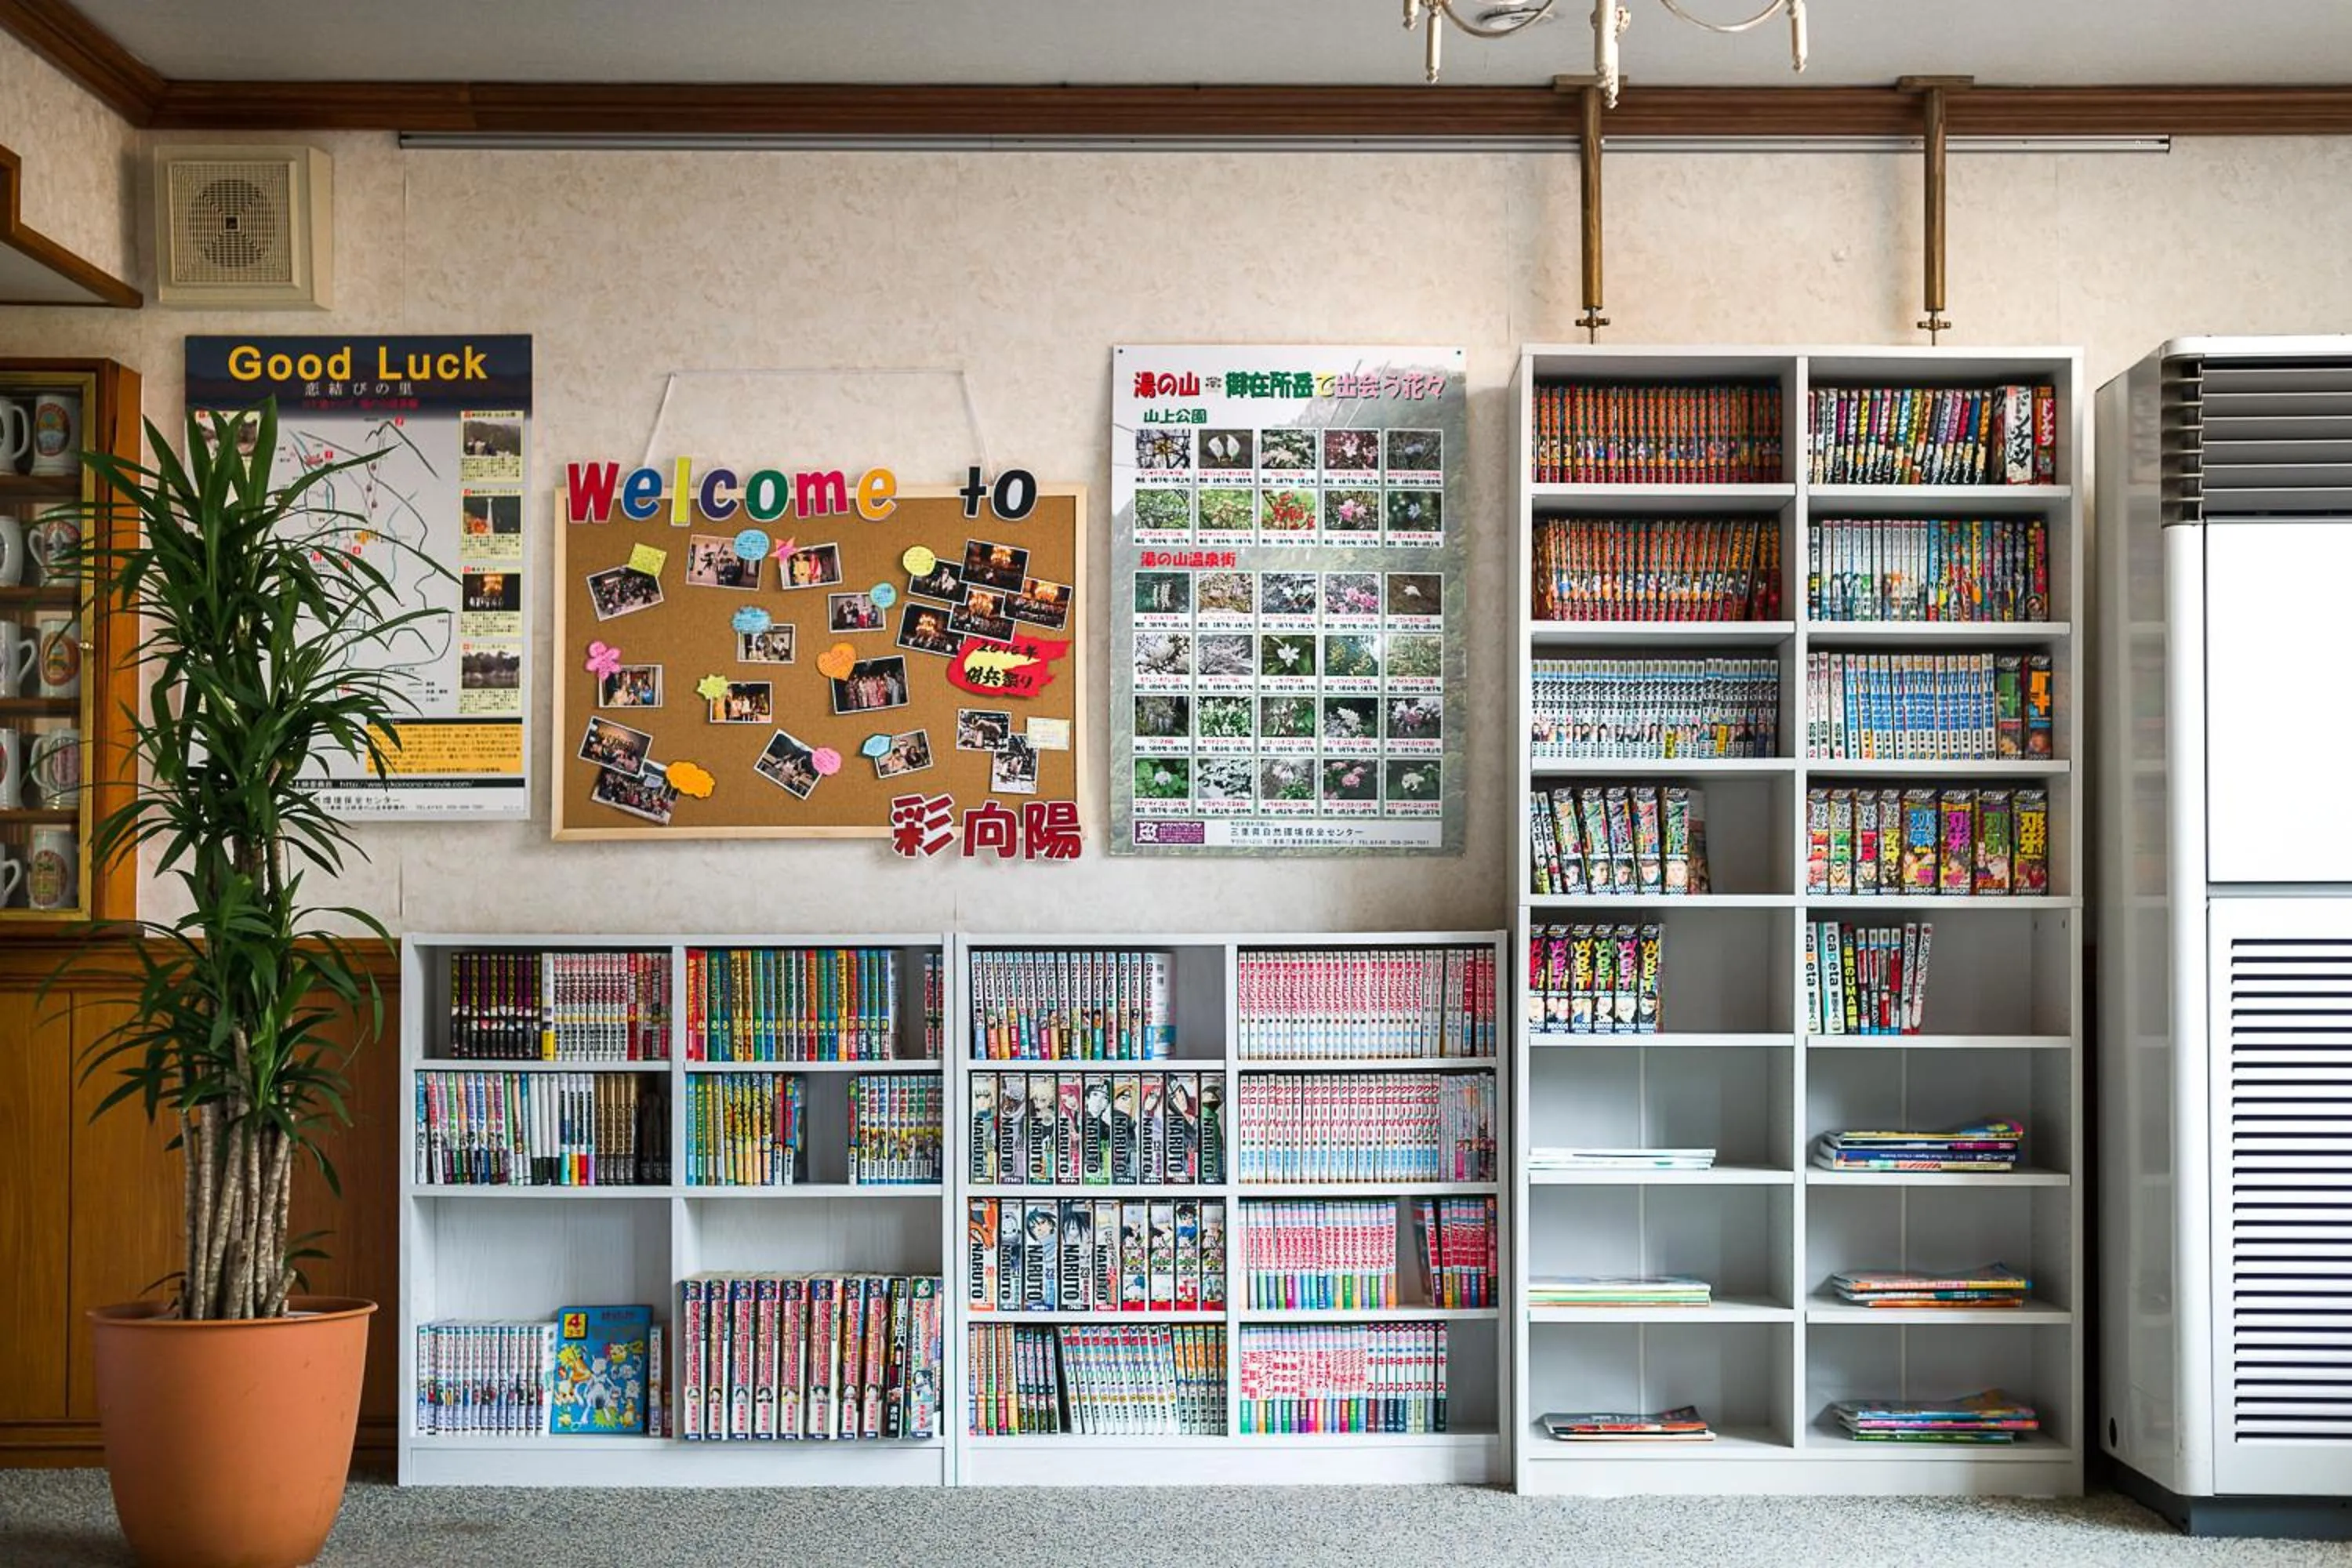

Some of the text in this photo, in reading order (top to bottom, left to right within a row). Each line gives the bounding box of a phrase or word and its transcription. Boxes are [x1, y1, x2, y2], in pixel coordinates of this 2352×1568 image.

[228, 346, 488, 380] Good Luck
[305, 382, 412, 396] 恋結びの里
[1134, 372, 1200, 397] 湯の山
[1143, 408, 1207, 424] 山上公園
[567, 457, 1036, 525] Welcome to
[1141, 552, 1236, 568] 湯の山温泉街
[891, 794, 1082, 859] 彩向陽
[1549, 938, 1569, 989] WORST
[1573, 938, 1592, 989] WORST
[1595, 938, 1613, 989] WORST
[1617, 938, 1637, 989] WORST
[1642, 939, 1658, 991] WORST
[1806, 934, 1817, 986] capeta
[1827, 934, 1839, 986] capeta
[974, 1117, 983, 1172] NARUTO
[1001, 1117, 1013, 1172] NARUTO
[1031, 1118, 1043, 1173] NARUTO
[1060, 1118, 1069, 1173] NARUTO
[1087, 1117, 1098, 1173] NARUTO
[1114, 1117, 1126, 1173] NARUTO
[1143, 1118, 1153, 1173] NARUTO
[1168, 1117, 1184, 1173] NARUTO
[1203, 1118, 1214, 1173] NARUTO
[971, 1243, 983, 1298] NARUTO
[1001, 1245, 1010, 1299] NARUTO
[1027, 1245, 1043, 1300] NARUTO
[1045, 1268, 1054, 1279] 22
[1063, 1245, 1079, 1300] NARUTO
[1098, 1245, 1107, 1300] NARUTO
[568, 1314, 582, 1328] 4
